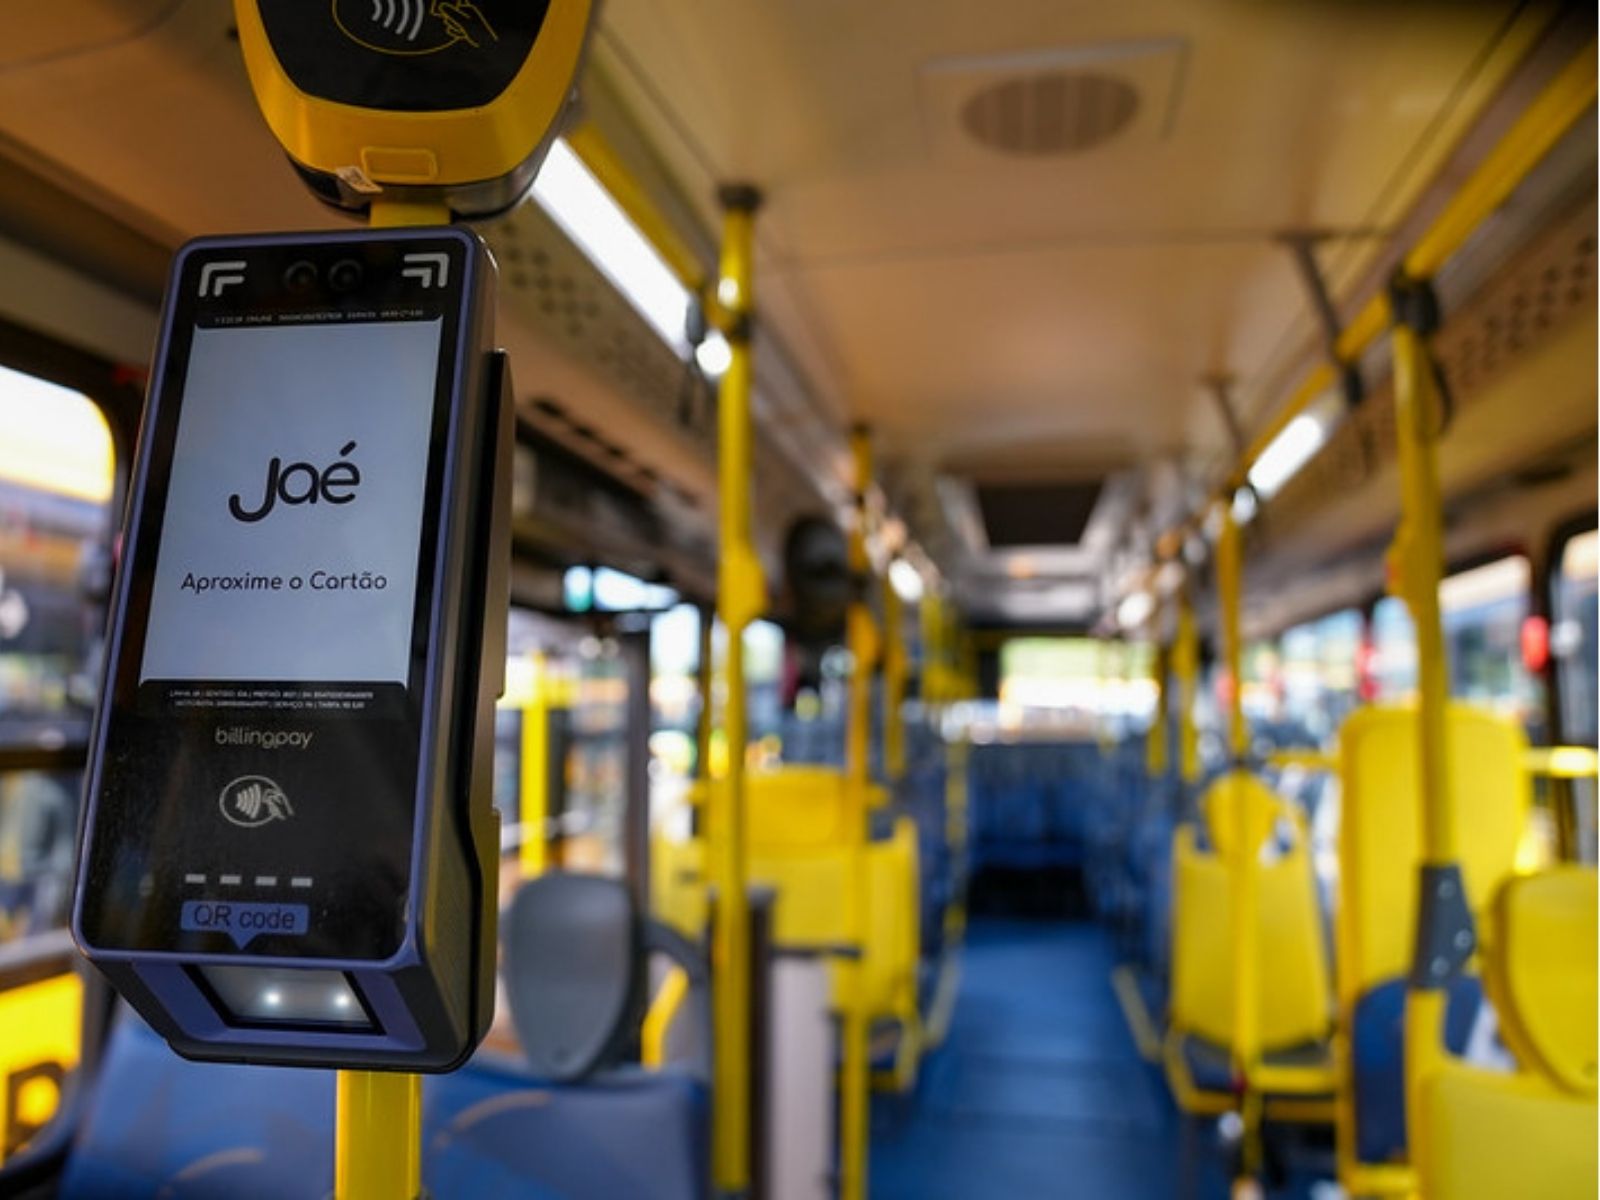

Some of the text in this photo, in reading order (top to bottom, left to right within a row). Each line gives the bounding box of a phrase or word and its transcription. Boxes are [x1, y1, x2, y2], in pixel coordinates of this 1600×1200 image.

[228, 440, 361, 522] Jaé
[180, 570, 388, 595] Aproxime o Cartão
[215, 727, 313, 749] billingpay
[193, 904, 296, 930] QR code
